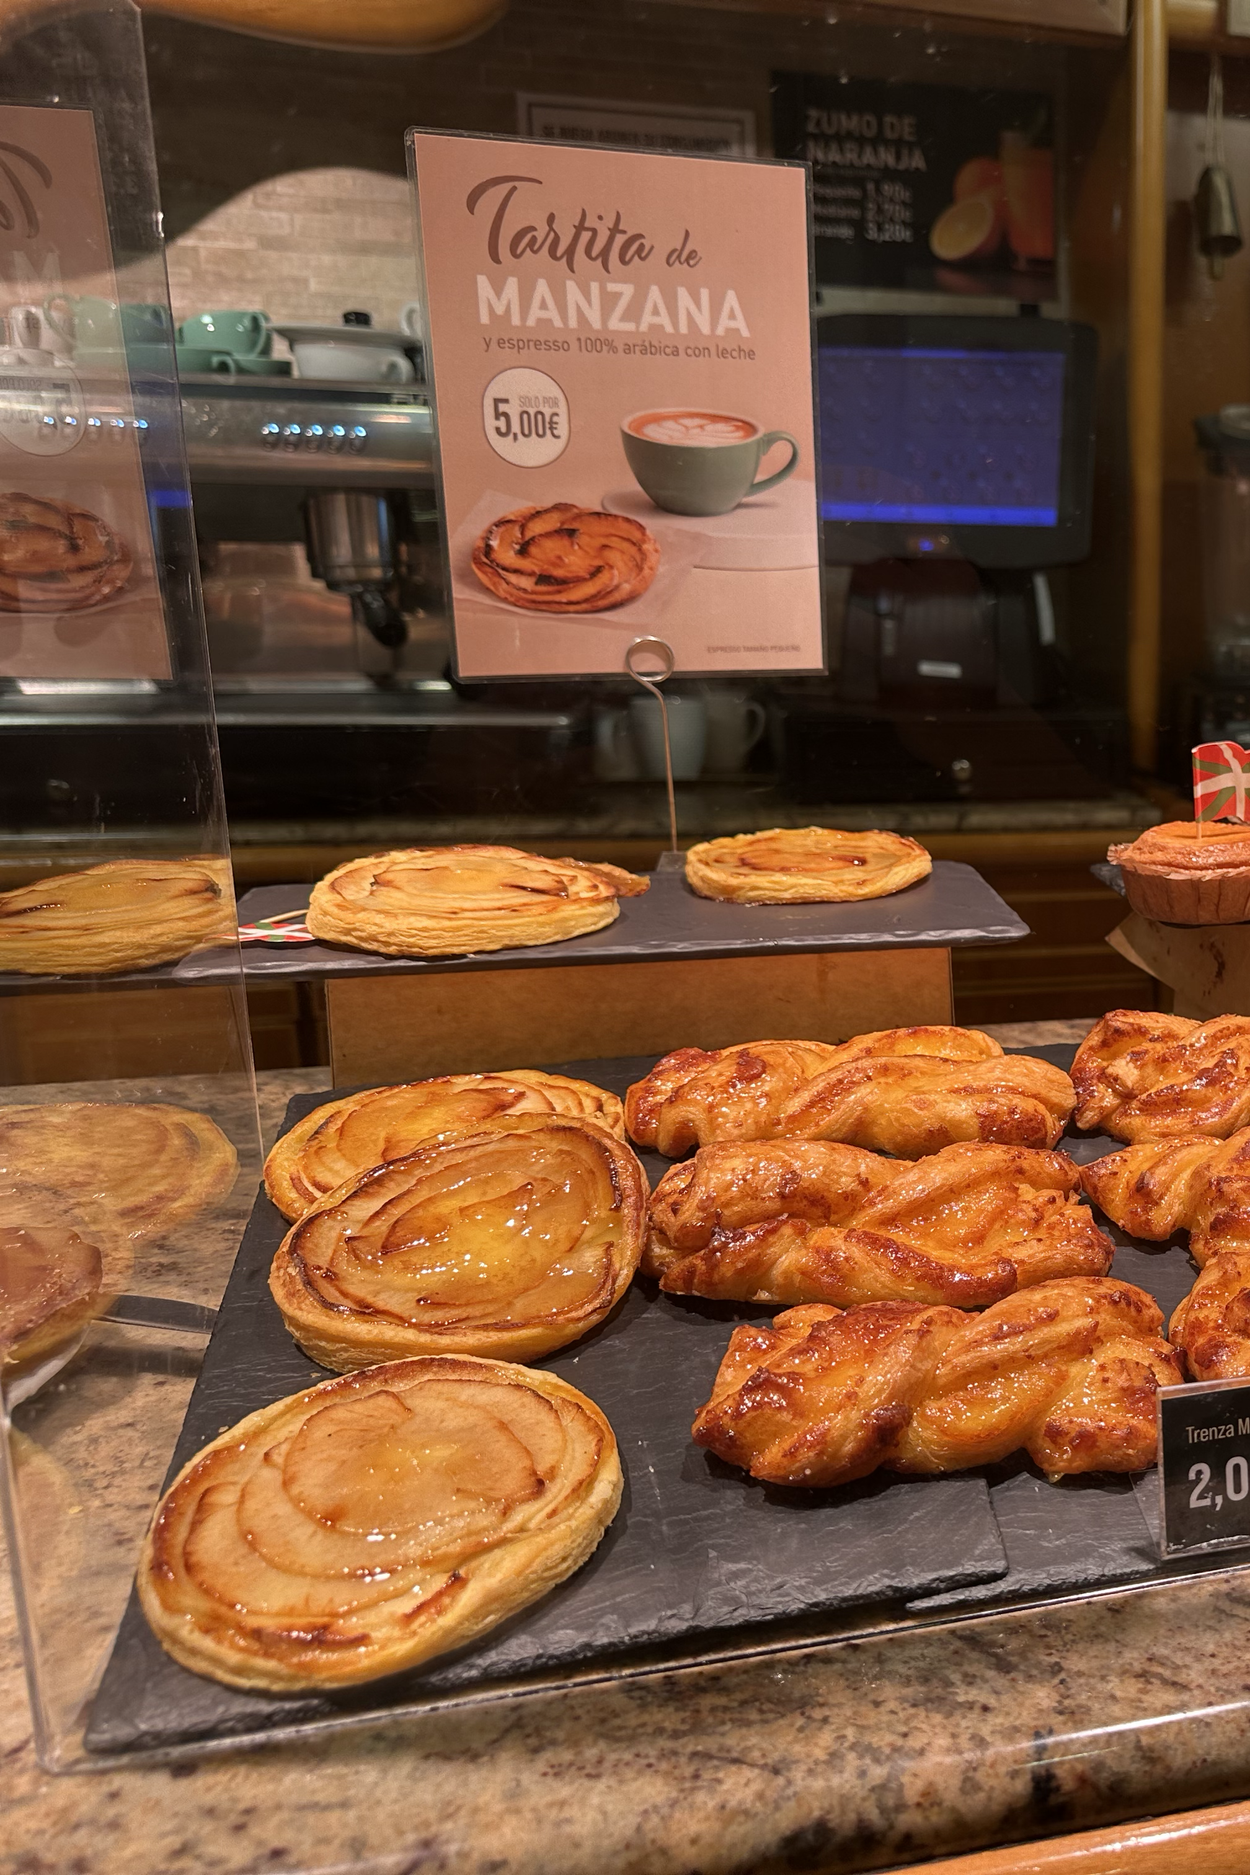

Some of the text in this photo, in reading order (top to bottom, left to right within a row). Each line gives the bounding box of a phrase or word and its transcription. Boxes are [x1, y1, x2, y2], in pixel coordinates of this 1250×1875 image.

[806, 107, 917, 141] ZUMO DE
[806, 137, 927, 172] NARANJA
[466, 175, 702, 275] Tartita de
[476, 274, 751, 338] MANZANA
[483, 337, 756, 361] y espresso 100% arábica con leche
[519, 396, 560, 409] SOLO POR
[493, 398, 561, 443] 5,00€
[1186, 1424, 1235, 1444] Trenza
